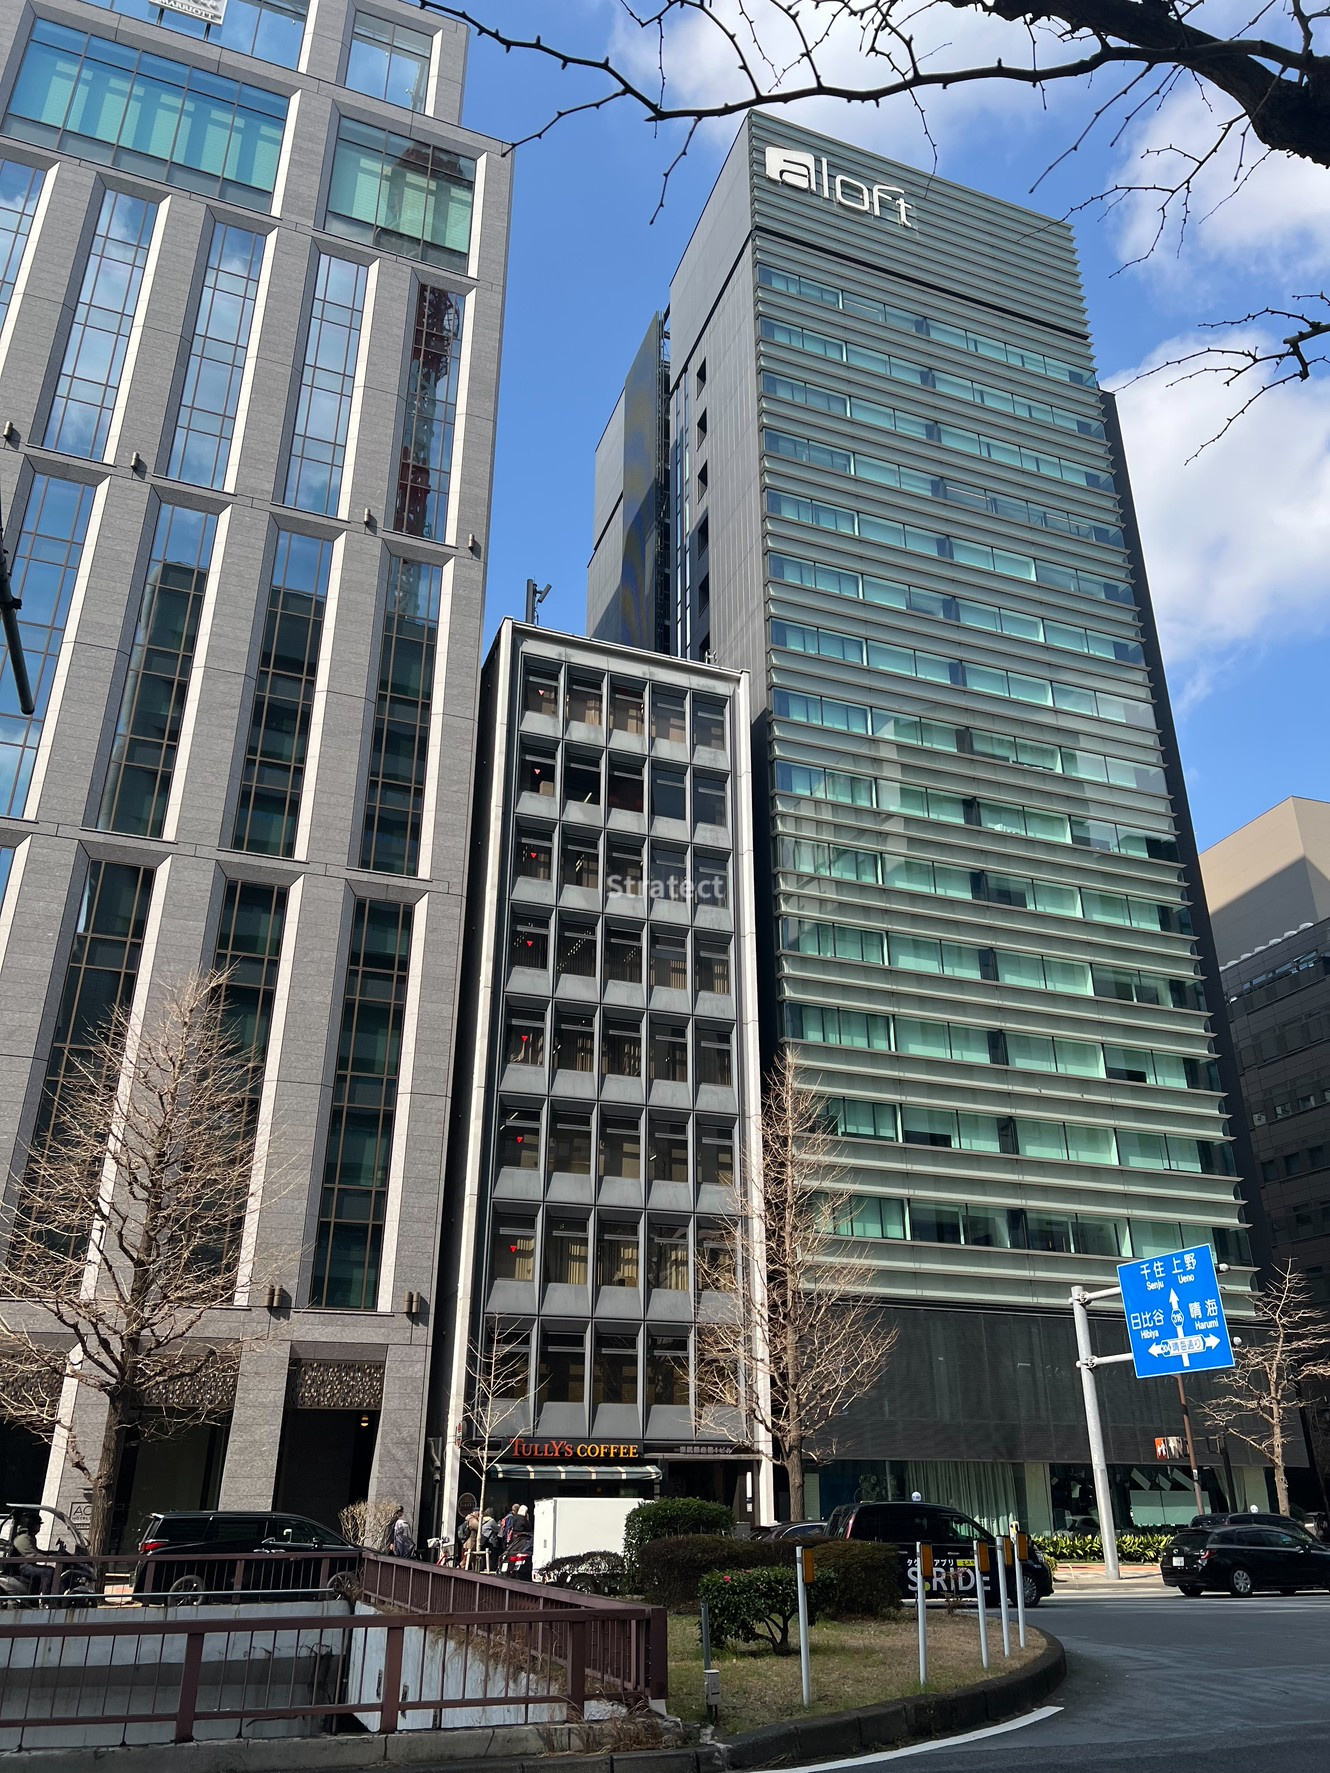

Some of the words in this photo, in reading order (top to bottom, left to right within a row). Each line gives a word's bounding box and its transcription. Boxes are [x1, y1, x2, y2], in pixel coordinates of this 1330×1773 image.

[765, 146, 912, 227] aloft
[1140, 1260, 1166, 1280] 千住
[1171, 1252, 1197, 1274] 上野
[1146, 1280, 1165, 1291] Senju
[1177, 1273, 1195, 1284] Ueno
[1188, 1298, 1218, 1319] 晴海
[1130, 1308, 1165, 1330] 日比谷
[1194, 1318, 1219, 1330] Harumi
[1140, 1329, 1160, 1340] Hibiya
[576, 1443, 639, 1457] COFFEE
[906, 1559, 954, 1567] タクアプリ
